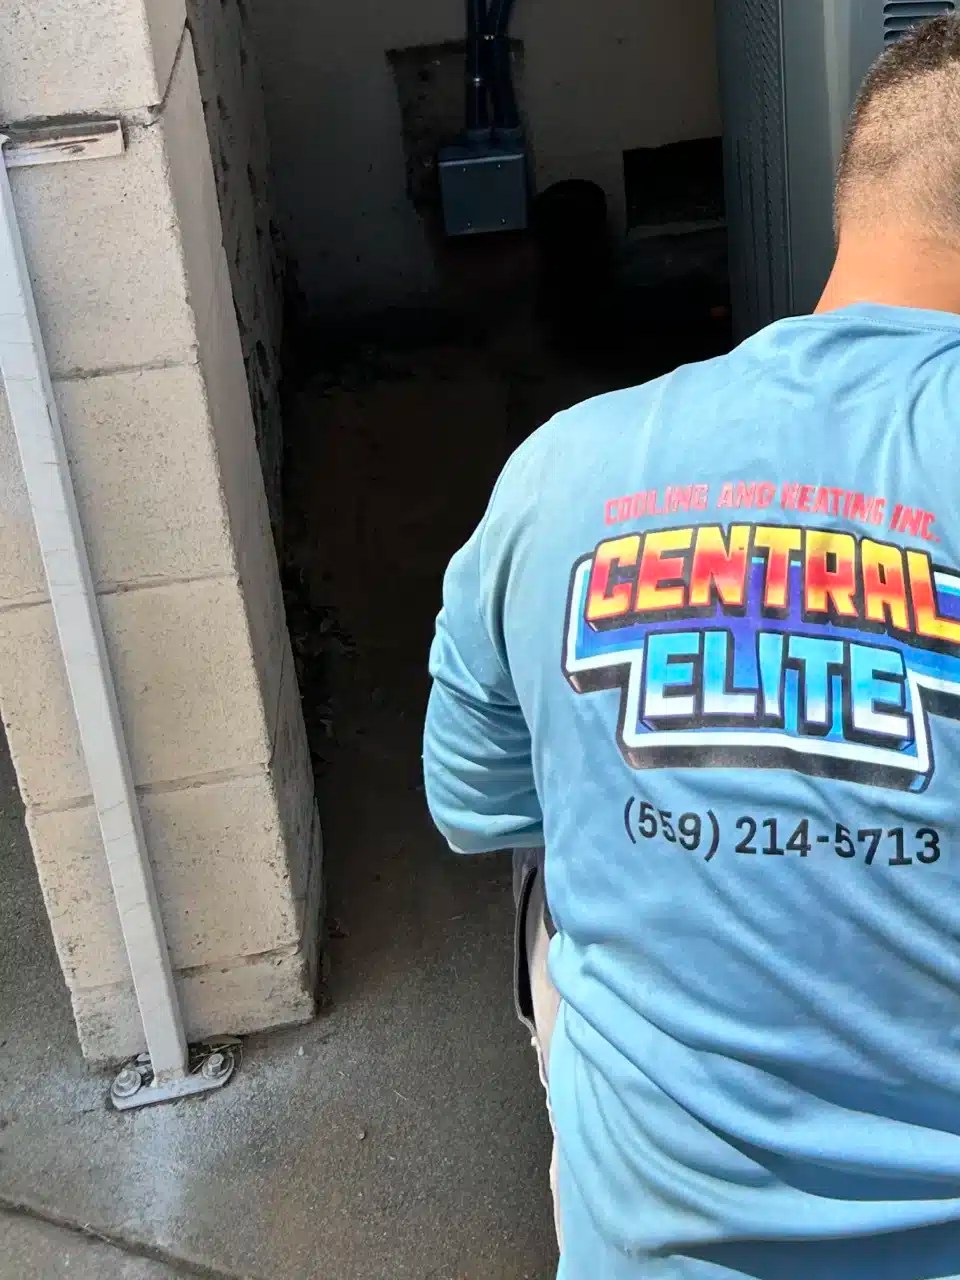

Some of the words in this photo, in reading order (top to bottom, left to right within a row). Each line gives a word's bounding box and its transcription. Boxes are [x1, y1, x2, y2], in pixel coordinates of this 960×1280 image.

[605, 484, 709, 525] COOLING
[717, 480, 776, 509] AND
[780, 481, 886, 525] HEATING
[889, 503, 941, 543] INC.
[642, 630, 914, 748] ELITE
[624, 796, 720, 862] (559)
[734, 815, 942, 867] 214-5713
